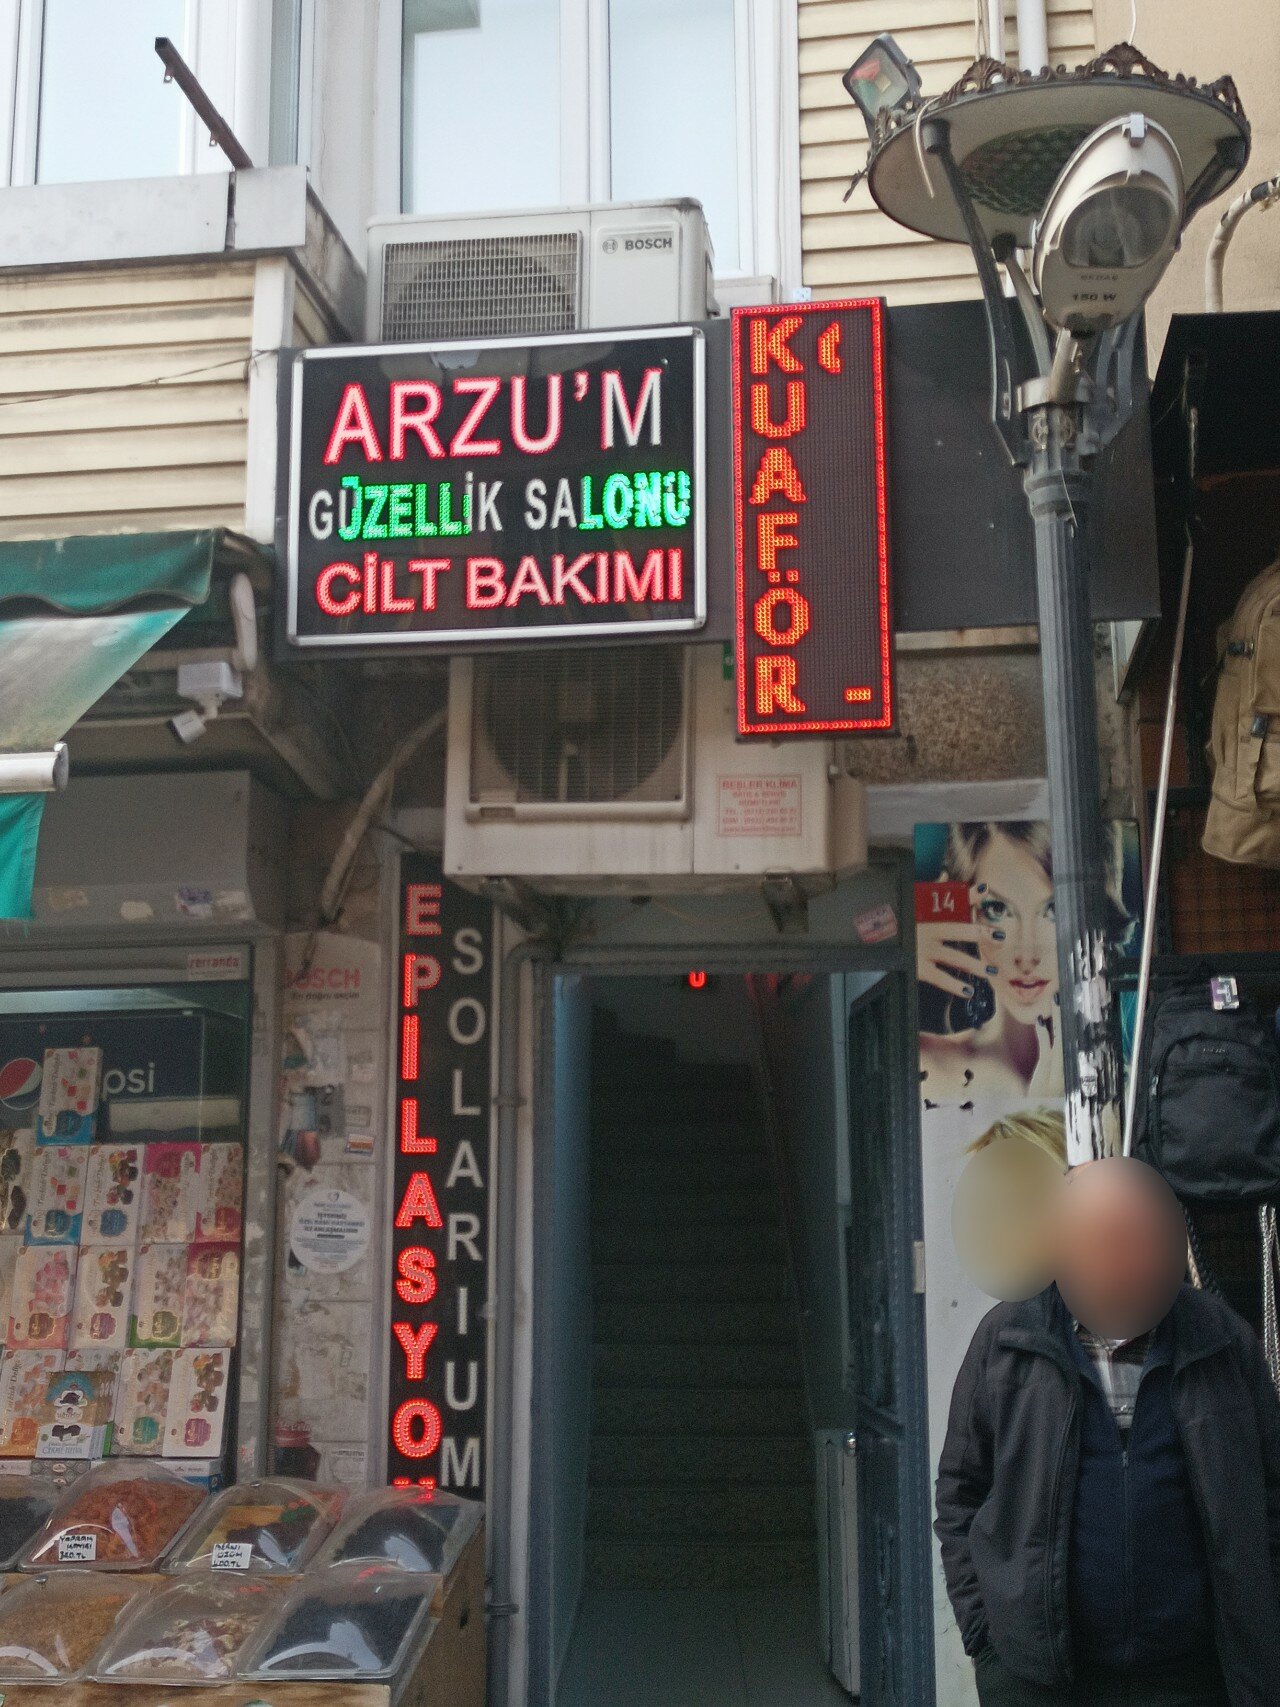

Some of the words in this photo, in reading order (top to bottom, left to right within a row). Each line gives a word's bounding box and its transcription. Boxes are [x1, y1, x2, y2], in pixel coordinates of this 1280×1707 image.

[625, 238, 672, 250] BOSCH
[323, 368, 663, 464] ARZU'M
[749, 315, 809, 717] KUAFÖR
[315, 552, 451, 616] CİLT
[465, 547, 684, 610] BAKIMI
[931, 891, 955, 913] 14
[102, 1062, 156, 1100] psi
[442, 927, 487, 1487] SOLARIUM
